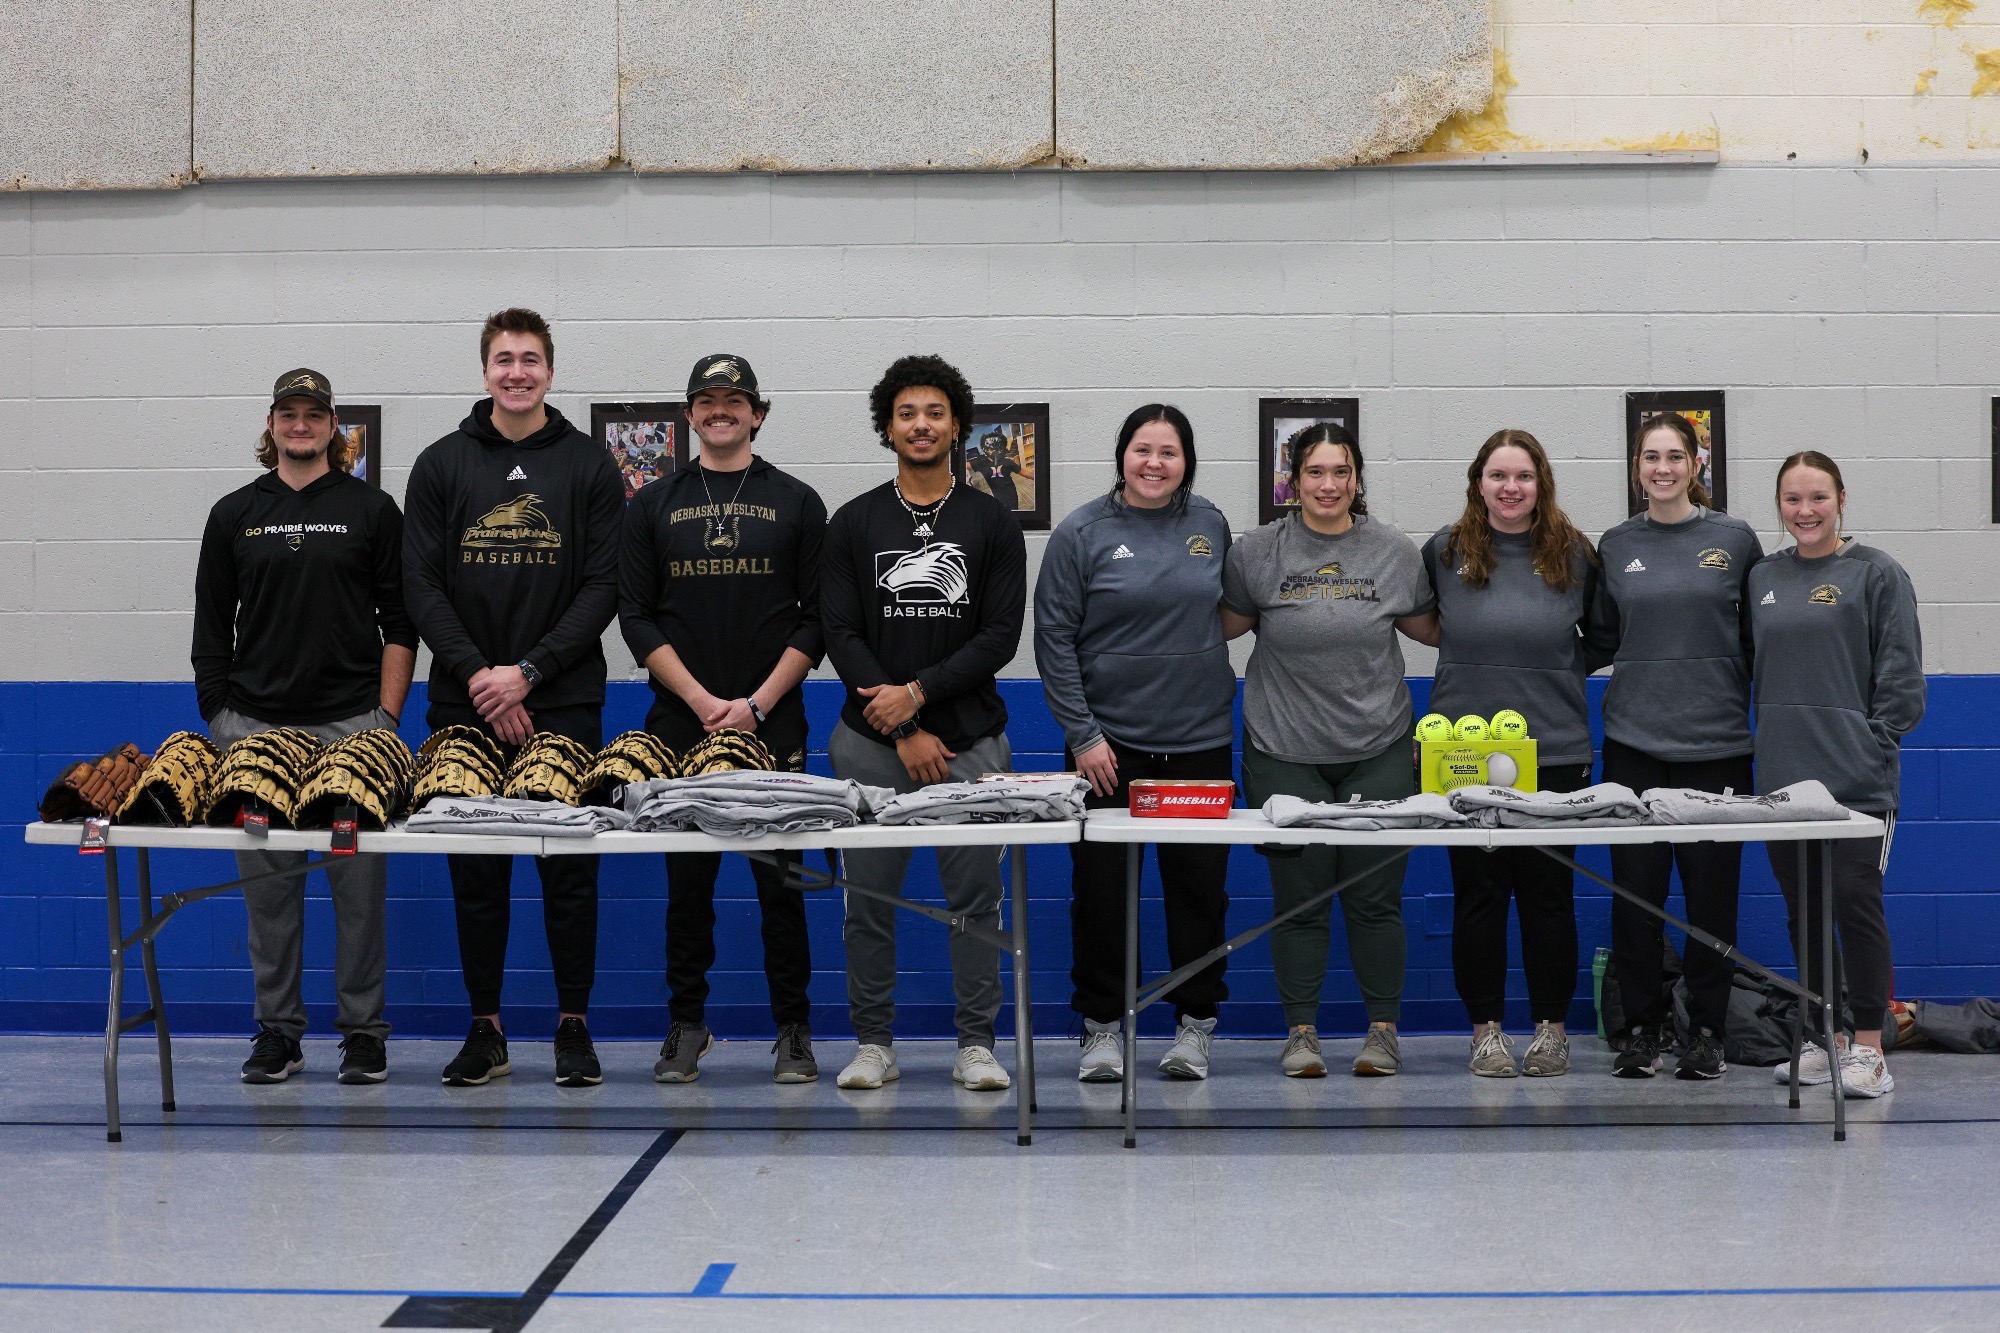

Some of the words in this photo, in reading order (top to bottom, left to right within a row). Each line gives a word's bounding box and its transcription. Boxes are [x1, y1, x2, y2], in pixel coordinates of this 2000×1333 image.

[670, 503, 720, 525] NEBRASKA
[722, 502, 776, 522] WESLEYAN
[245, 527, 263, 537] GO
[264, 523, 303, 535] PRAIRIE
[304, 523, 348, 534] WOLVES
[462, 551, 557, 565] BASEBALL
[669, 558, 775, 578] BASEBALL
[1286, 575, 1330, 585] NEBRASKA
[1331, 578, 1376, 586] WESLEYAN
[1279, 581, 1381, 603] SOFTBALL
[883, 605, 962, 618] BASEBALL
[1425, 719, 1442, 729] NCAA
[1161, 796, 1227, 805] BASEBALLS
